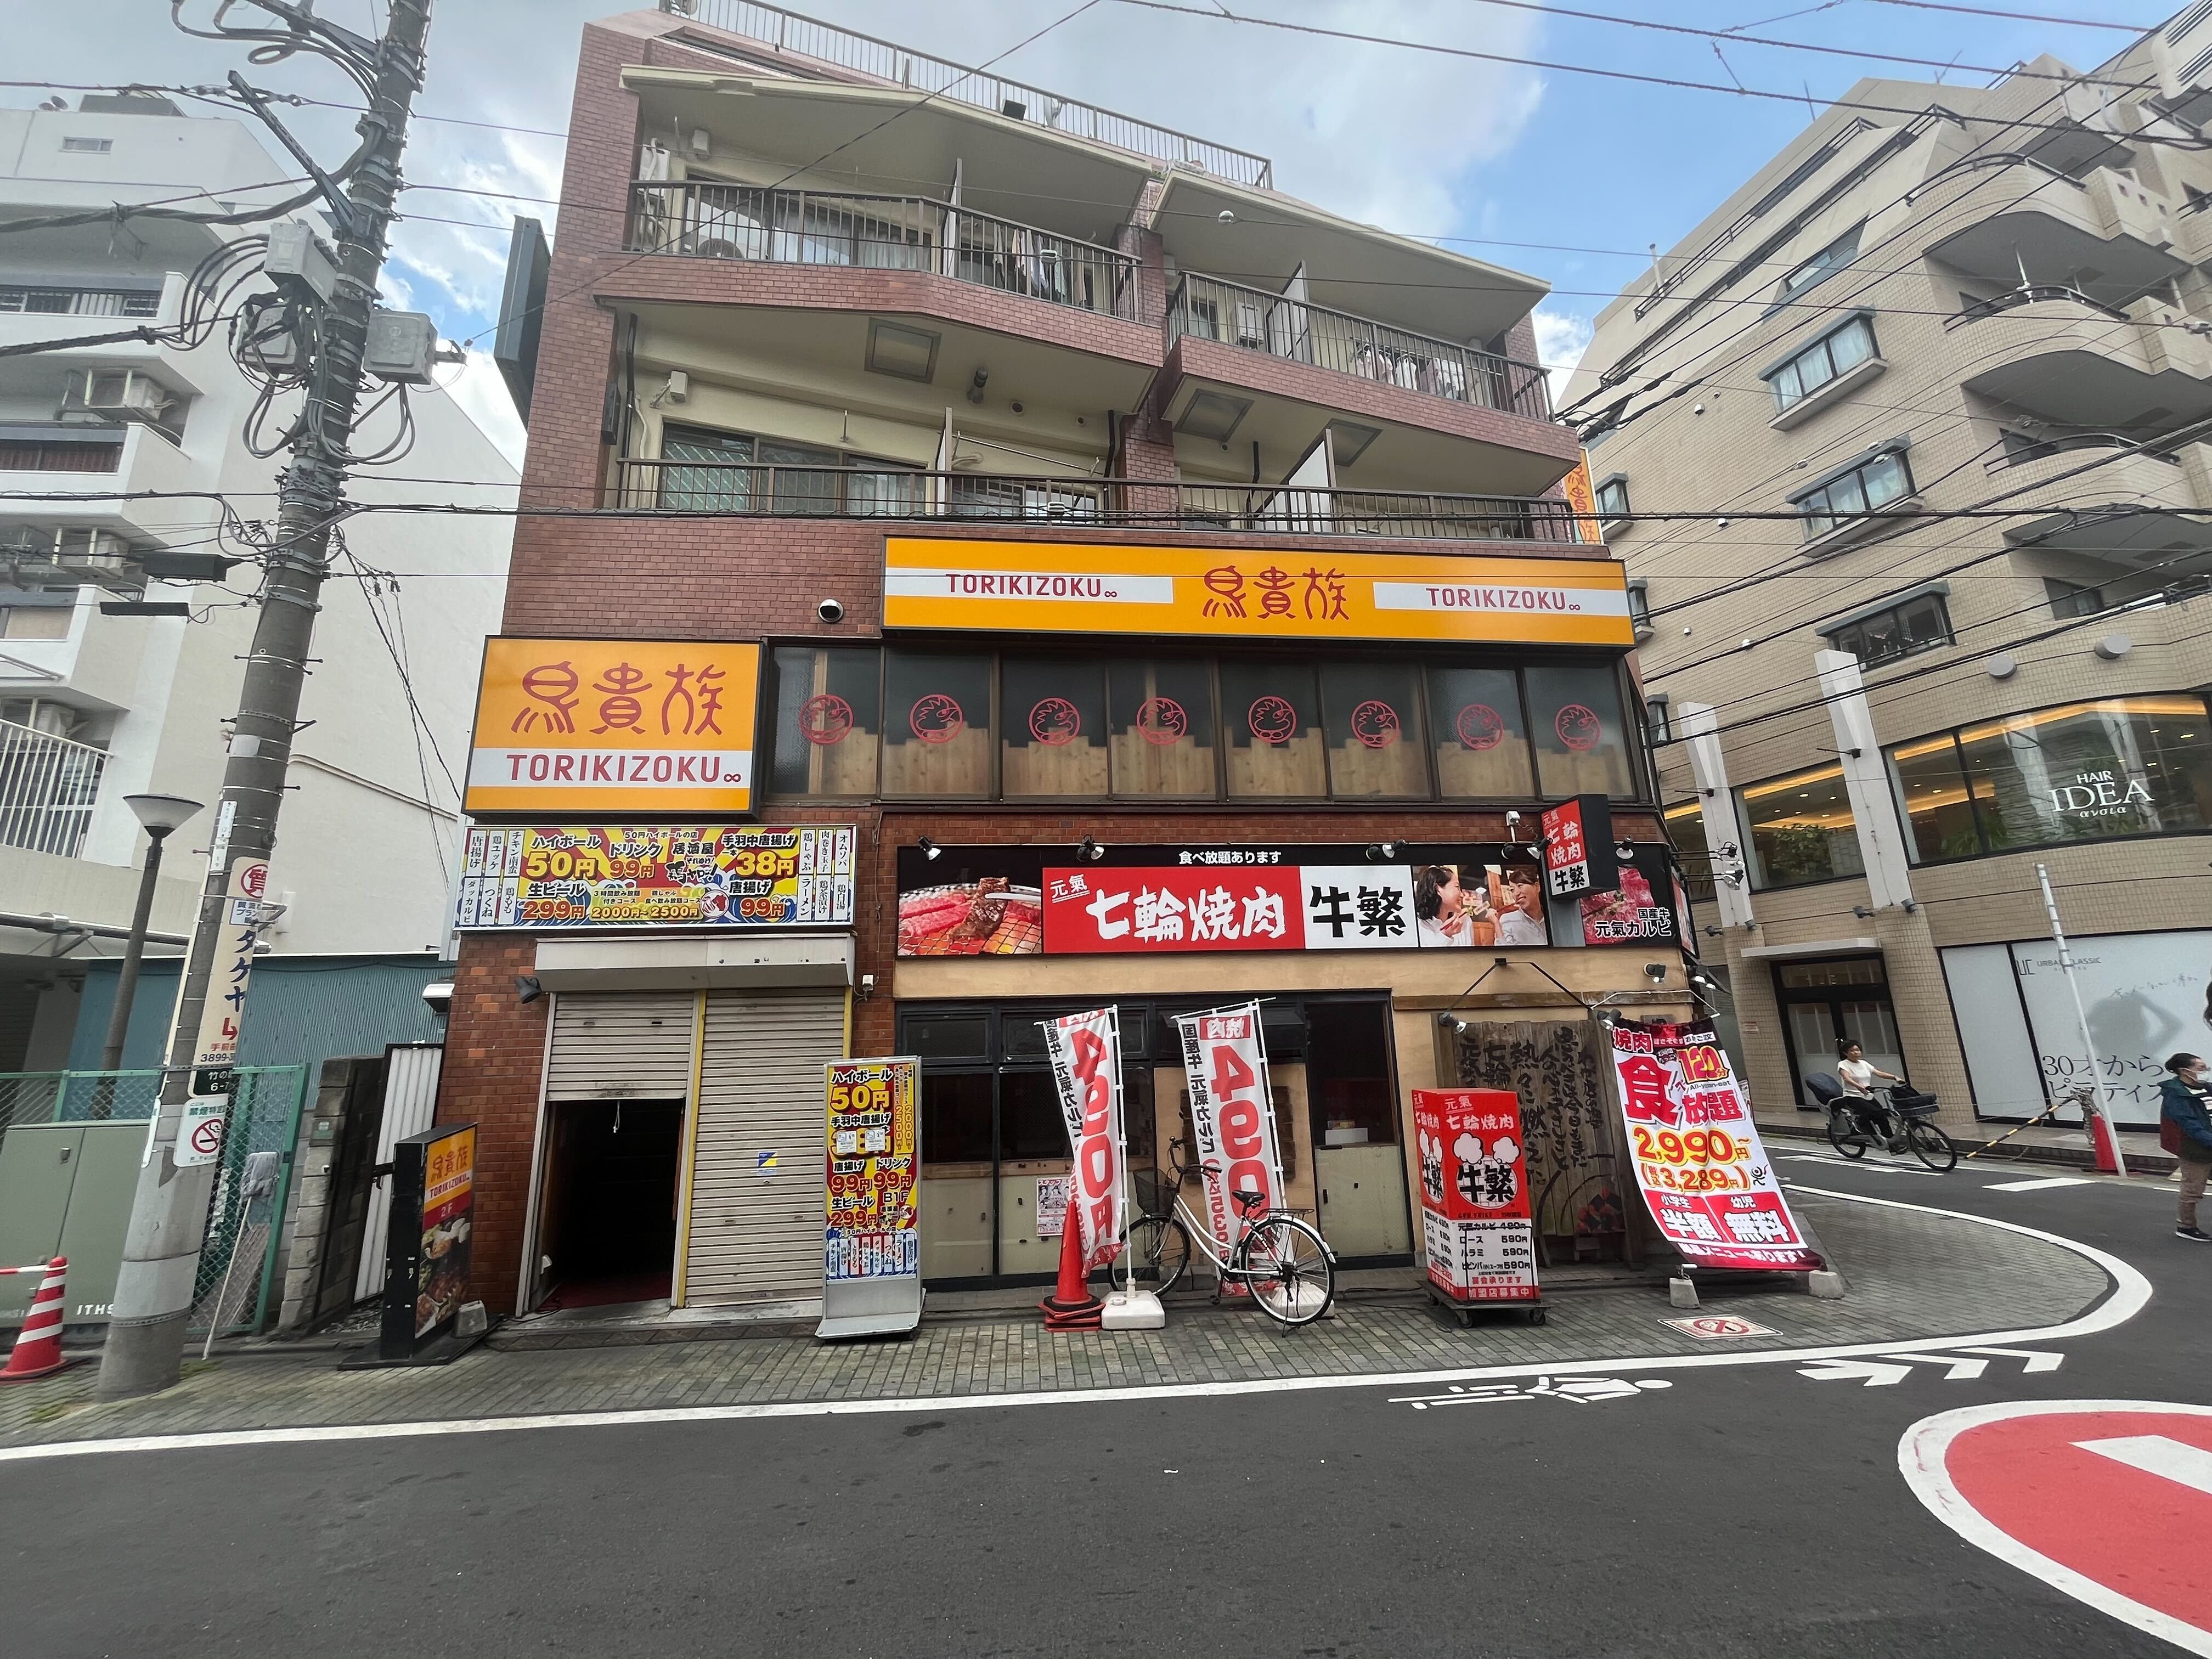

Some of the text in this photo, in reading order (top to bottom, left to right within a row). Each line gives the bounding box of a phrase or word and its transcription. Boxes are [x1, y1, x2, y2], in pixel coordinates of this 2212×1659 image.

[946, 573, 1102, 597] TORIKIZOKU
[1202, 565, 1350, 620] 鳥貴族
[1425, 588, 1567, 611] TORIKIZOKU
[511, 661, 726, 736] 鳥貴族
[506, 754, 721, 783] TORIKIZOKU
[2076, 770, 2113, 785] HAIR
[2048, 780, 2155, 812] IDEA
[532, 833, 602, 850] ハイボール
[723, 834, 797, 847] 手羽中唐揚げ
[1547, 820, 1579, 845] 七輪
[470, 836, 483, 868] 唐揚げ
[490, 835, 502, 870] 鶏ユッケ
[509, 831, 521, 874] チキン南蛮
[610, 842, 662, 857] ドリンク
[673, 842, 714, 855] 居酒屋
[802, 832, 812, 871] 鶏しゃぶ
[819, 830, 830, 872] 肉巻き玉子
[838, 834, 848, 867] オムソバ
[1178, 850, 1282, 865] 食べ放題あります
[1551, 841, 1582, 867] 焼肉
[526, 851, 598, 878] 50円
[610, 859, 654, 878] 99円
[736, 851, 794, 876] 38円
[729, 880, 772, 894] 唐揚げ
[1049, 872, 1090, 898] 元氣
[1554, 865, 1585, 892] 牛繁
[528, 882, 586, 898] 生ビール
[800, 879, 811, 916] ラーメン
[818, 880, 829, 915] 鶏茶漬け
[481, 889, 495, 917] つくね
[522, 900, 585, 921] 299円
[651, 906, 698, 918] 2500円
[740, 897, 786, 917] 99円
[1085, 884, 1286, 944] 七輪焼肉
[1309, 884, 1407, 939] 牛繁
[1637, 907, 1670, 920] 国産牛
[1594, 919, 1673, 939] 元氣カルビ
[1612, 1026, 1653, 1052] 焼肉
[831, 1069, 894, 1084] ハイボール
[830, 1085, 890, 1110] 50円
[1444, 1095, 1472, 1110] 元氣
[831, 1113, 891, 1127] 手羽中唐揚げ
[1446, 1113, 1514, 1131] 七輪焼肉
[430, 1145, 469, 1183] 鳥貴族
[833, 1158, 912, 1173] 唐揚げ ドリンク
[831, 1171, 912, 1193] 99円 99円
[1457, 1164, 1515, 1203] 牛繁
[831, 1195, 876, 1211] 生ビール
[883, 1190, 910, 1203] B1F
[1661, 1195, 1757, 1209] 小学生 幼児
[441, 1202, 453, 1218] 2F
[831, 1210, 878, 1227] 299円
[1659, 1208, 1791, 1243] 半額 無料
[1501, 1234, 1528, 1244] 590円
[1502, 1248, 1530, 1257] 590円
[1504, 1261, 1531, 1269] 590円
